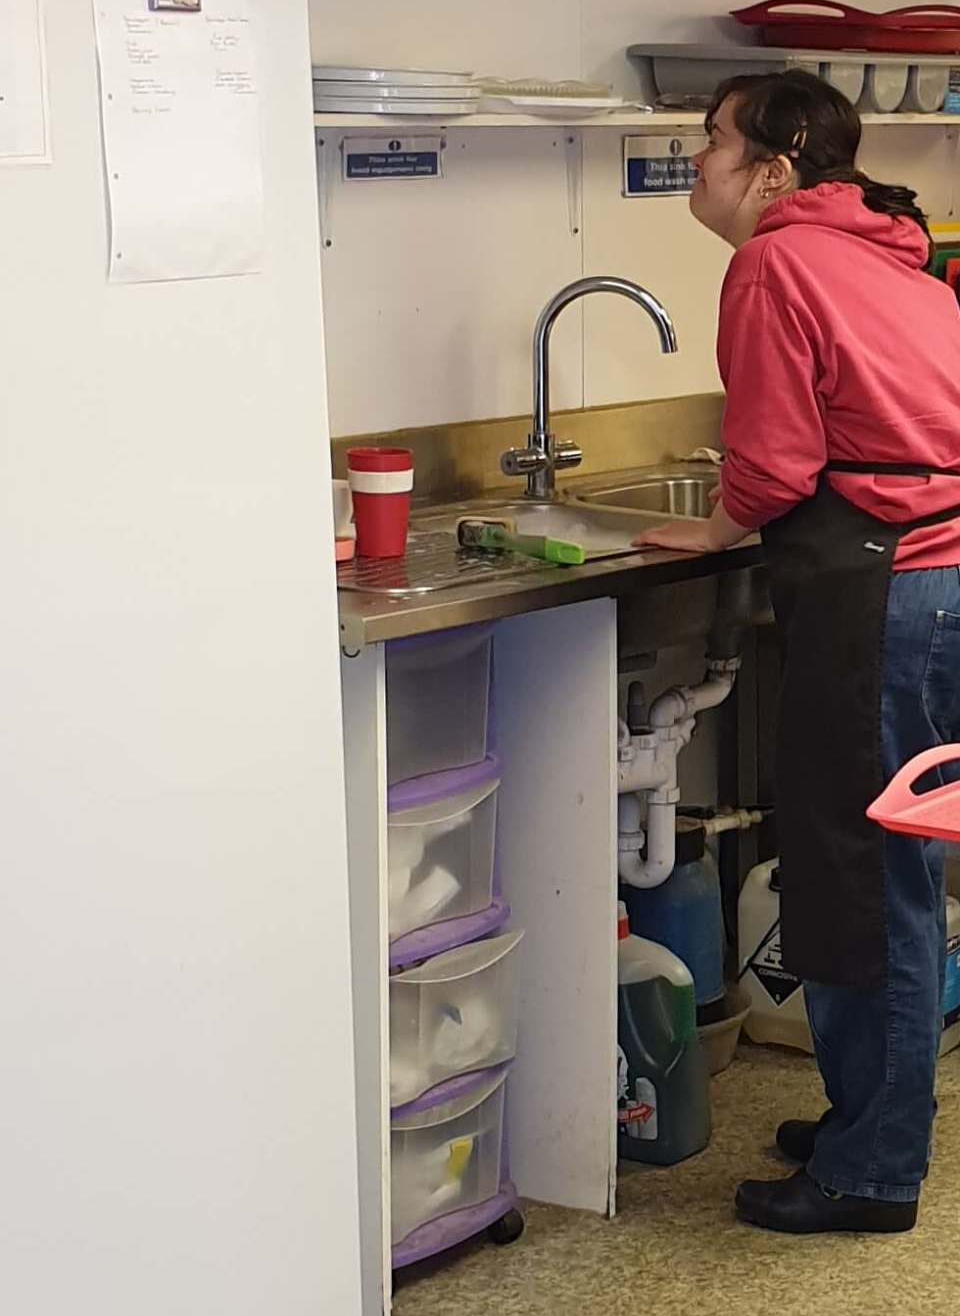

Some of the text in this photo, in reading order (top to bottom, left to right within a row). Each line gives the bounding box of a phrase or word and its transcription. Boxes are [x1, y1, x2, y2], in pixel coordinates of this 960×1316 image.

[650, 162, 668, 171] This
[669, 161, 686, 170] sink
[643, 177, 663, 187] food
[664, 177, 686, 186] wash
